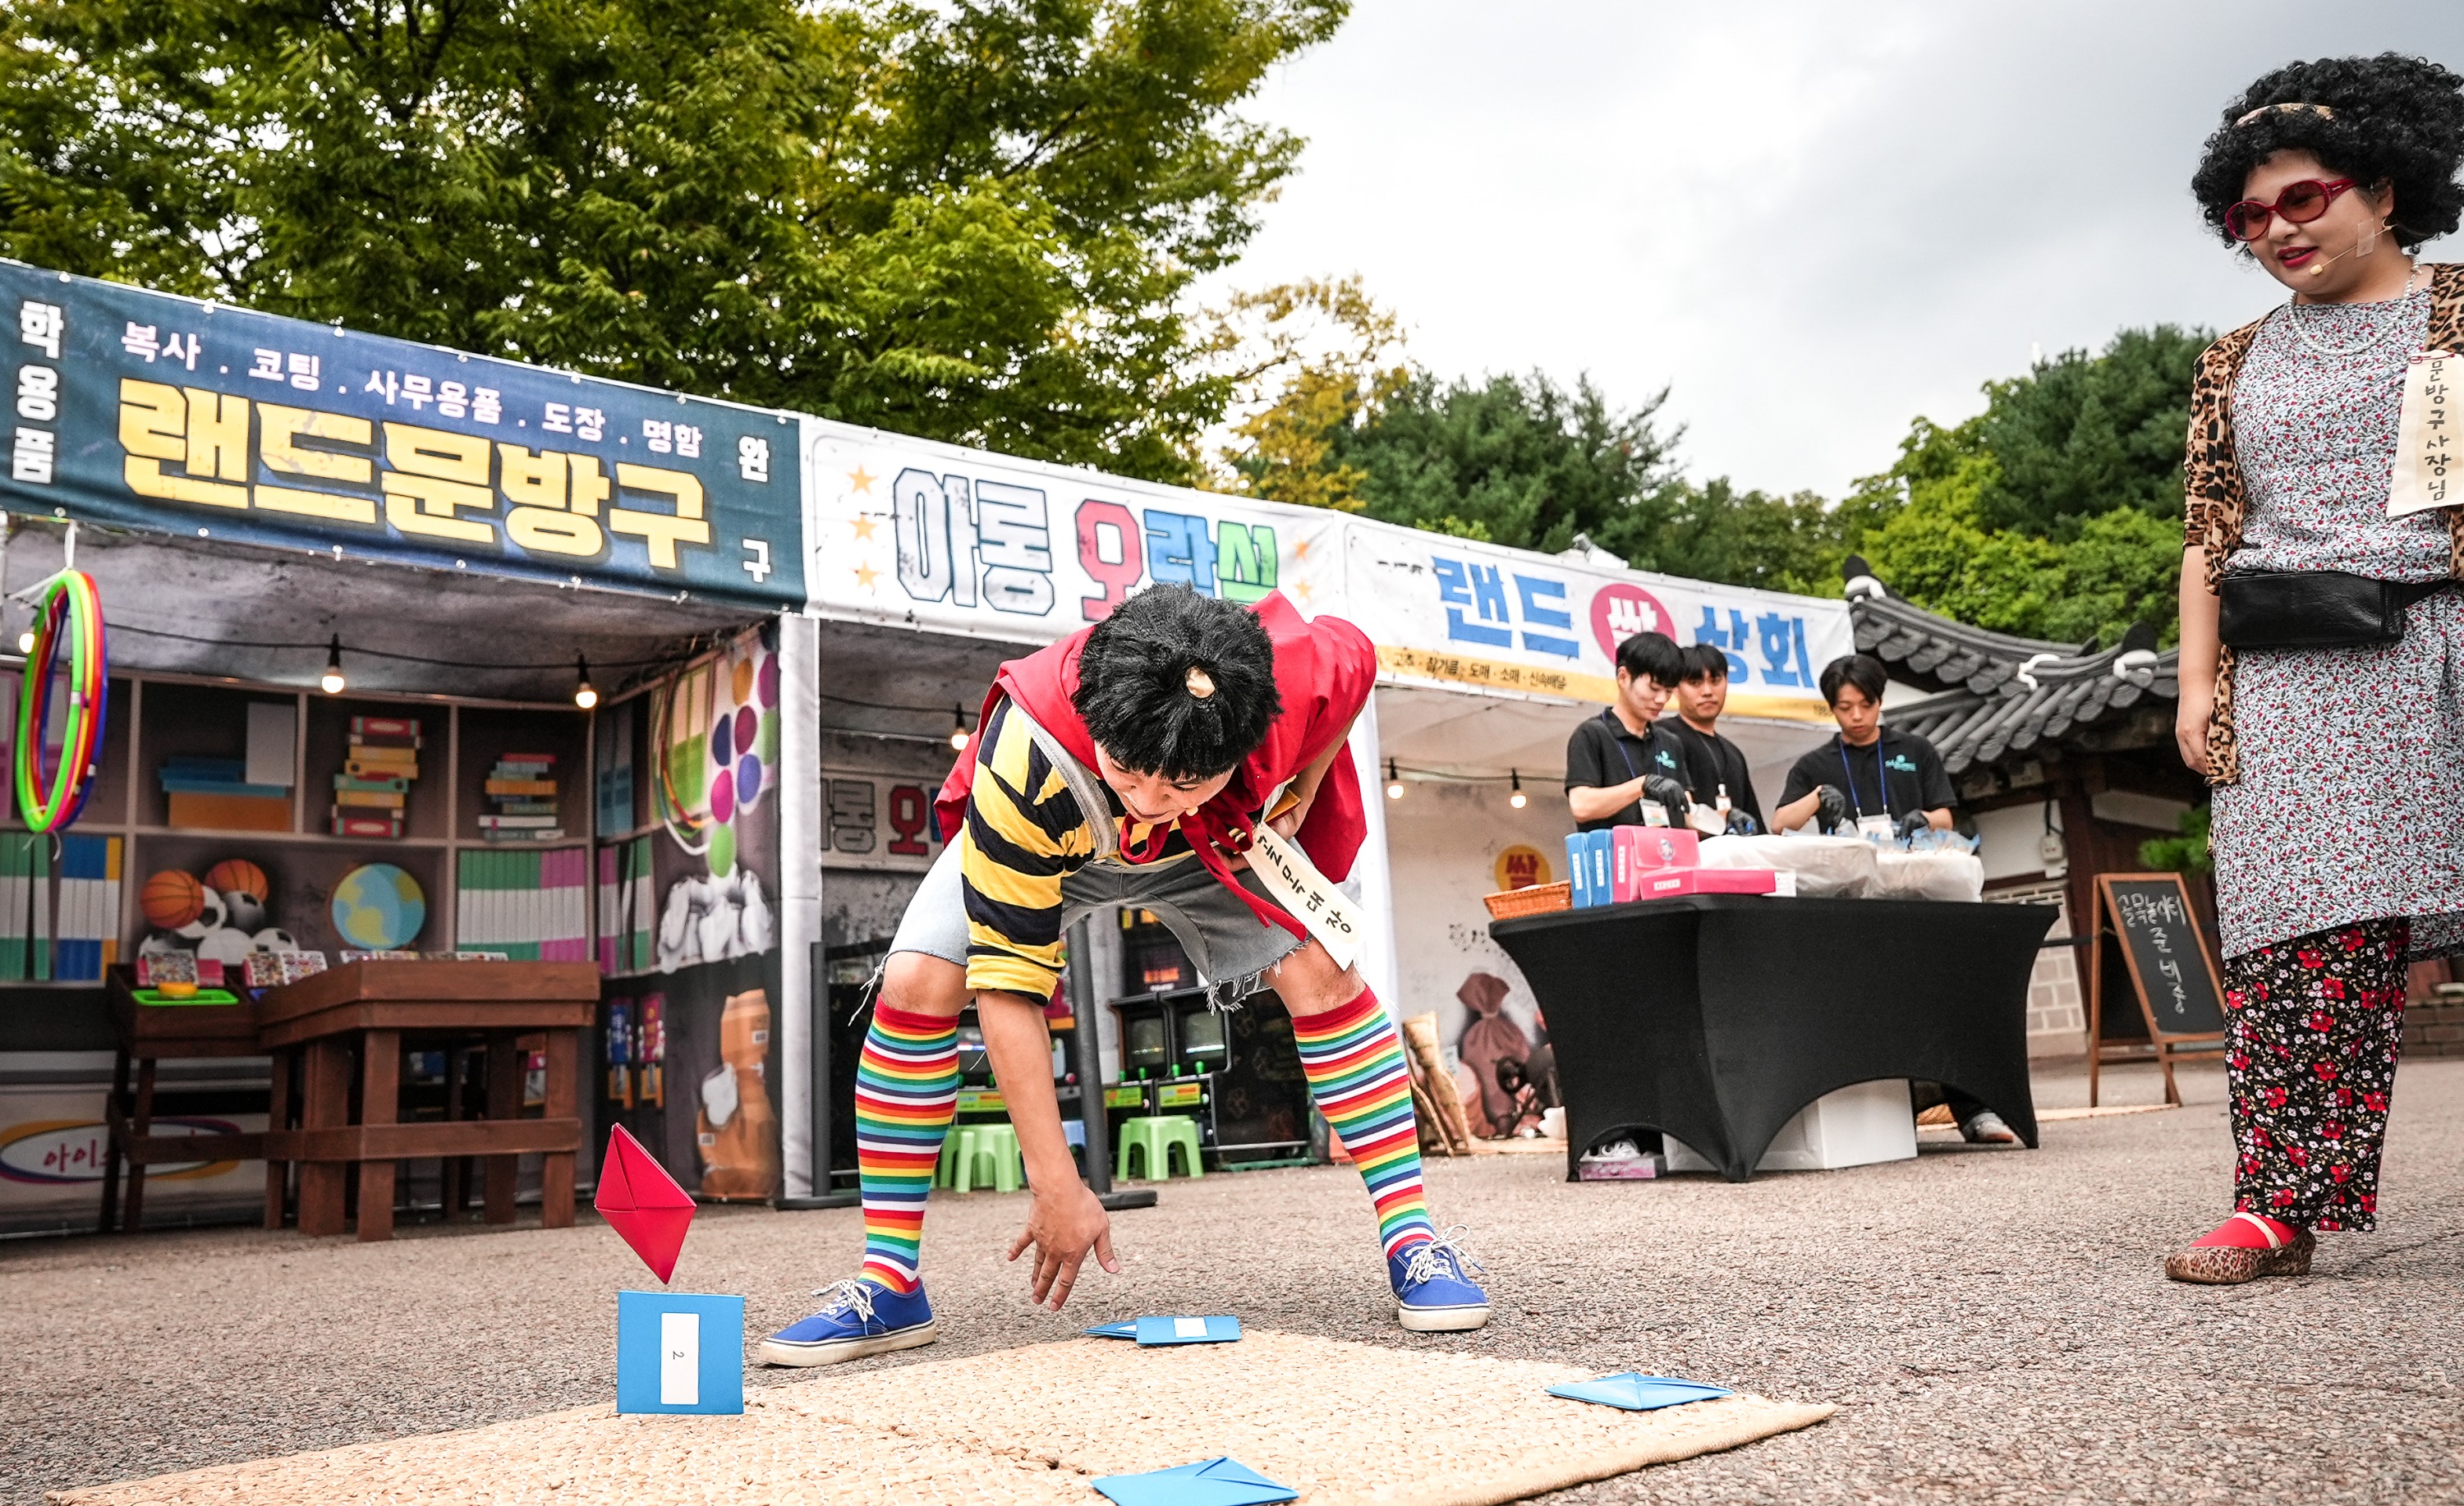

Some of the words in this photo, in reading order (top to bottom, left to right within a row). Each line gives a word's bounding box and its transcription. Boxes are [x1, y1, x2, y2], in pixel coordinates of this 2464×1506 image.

[11, 299, 65, 484] 학용품
[121, 320, 202, 371] 복사
[248, 347, 320, 392] 코팅
[364, 369, 503, 425] 사무용품
[541, 401, 606, 442] 도장
[642, 418, 703, 458] 명함
[2425, 360, 2453, 501] 문방구사장님
[118, 377, 711, 569] 랜드문방구
[739, 434, 771, 583] 완구
[893, 466, 1055, 617] 아롱
[1431, 555, 1579, 660] 랜드
[1694, 605, 1816, 689] 상회
[1469, 662, 1490, 680] 도매
[1500, 668, 1520, 684] 소매
[1529, 671, 1567, 691] 신속배달
[1257, 834, 1352, 934] 골목대장
[2149, 926, 2187, 1015] 준비중
[673, 1351, 685, 1360] 2
